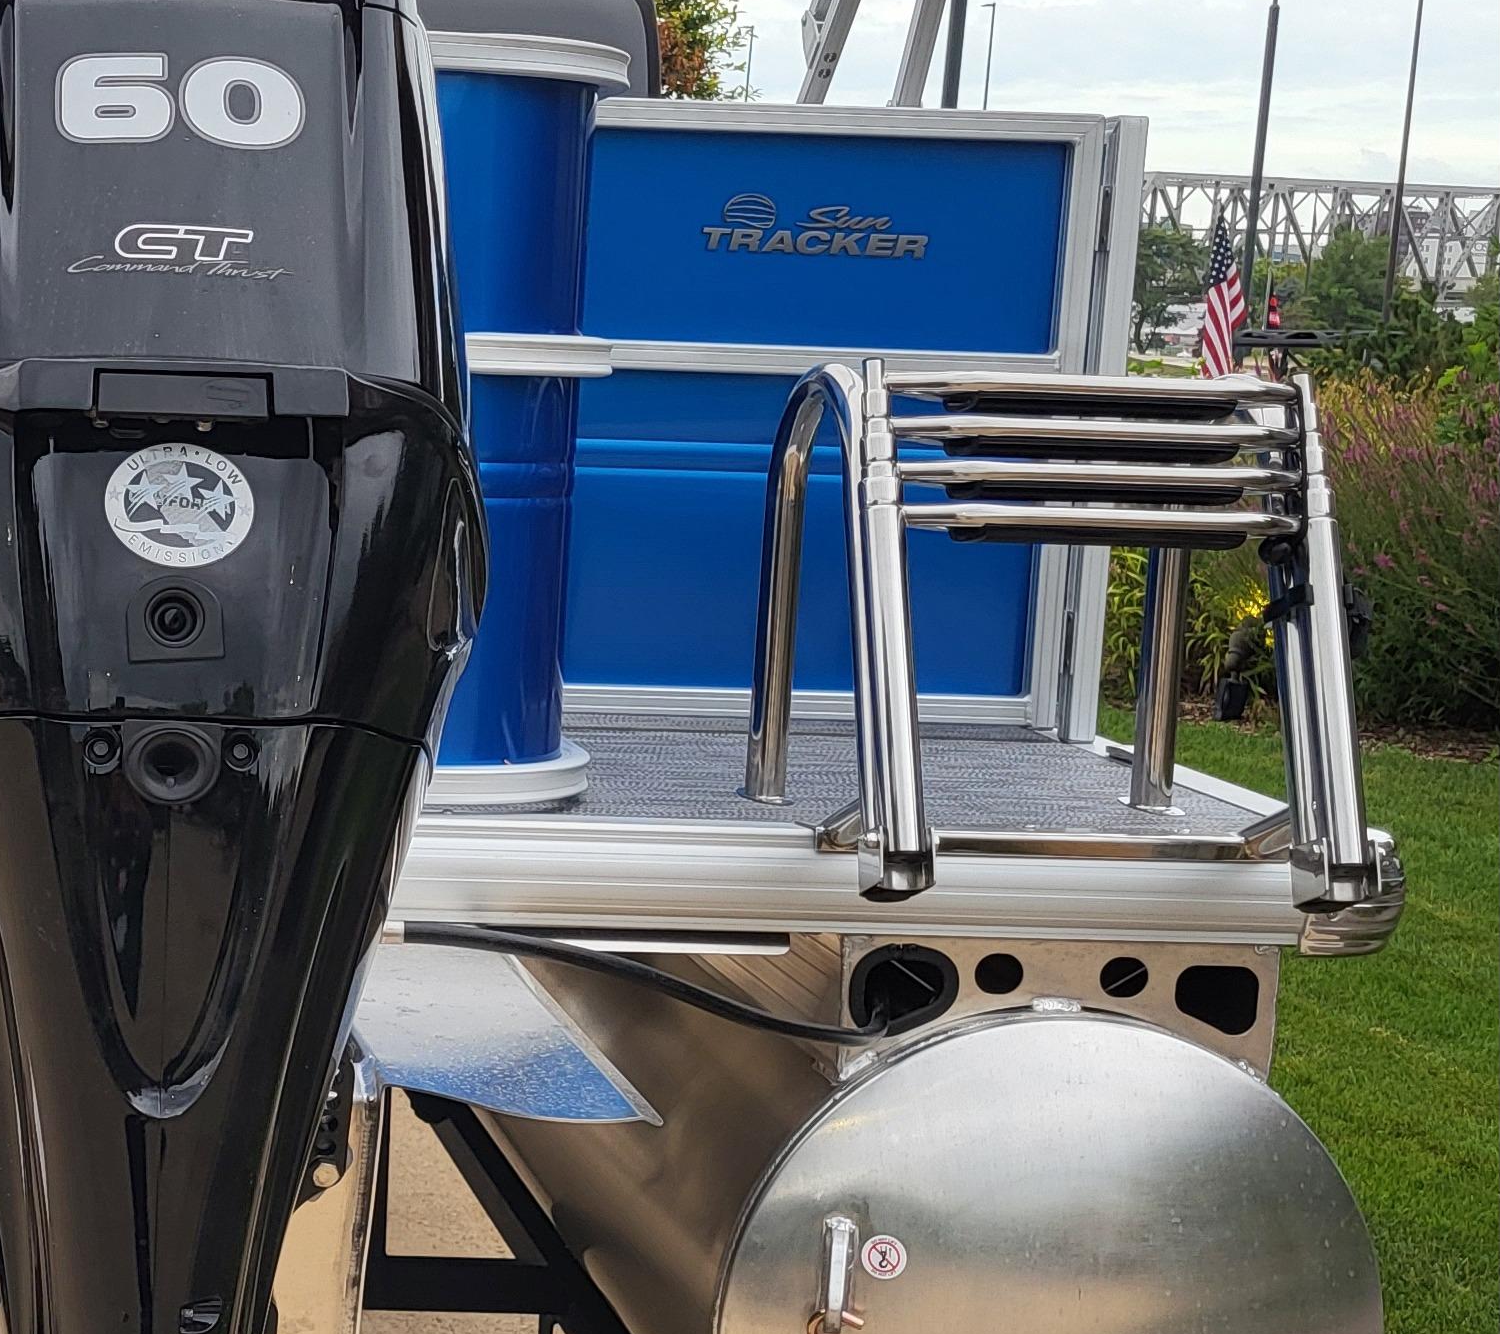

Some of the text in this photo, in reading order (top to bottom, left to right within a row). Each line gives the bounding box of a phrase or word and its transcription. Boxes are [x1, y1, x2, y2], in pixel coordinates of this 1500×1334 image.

[55, 52, 307, 151] 60
[795, 206, 893, 230] Sun
[702, 226, 929, 260] TRACKER
[66, 255, 296, 280] Command Thrust
[126, 445, 243, 485] ULTRA LOW
